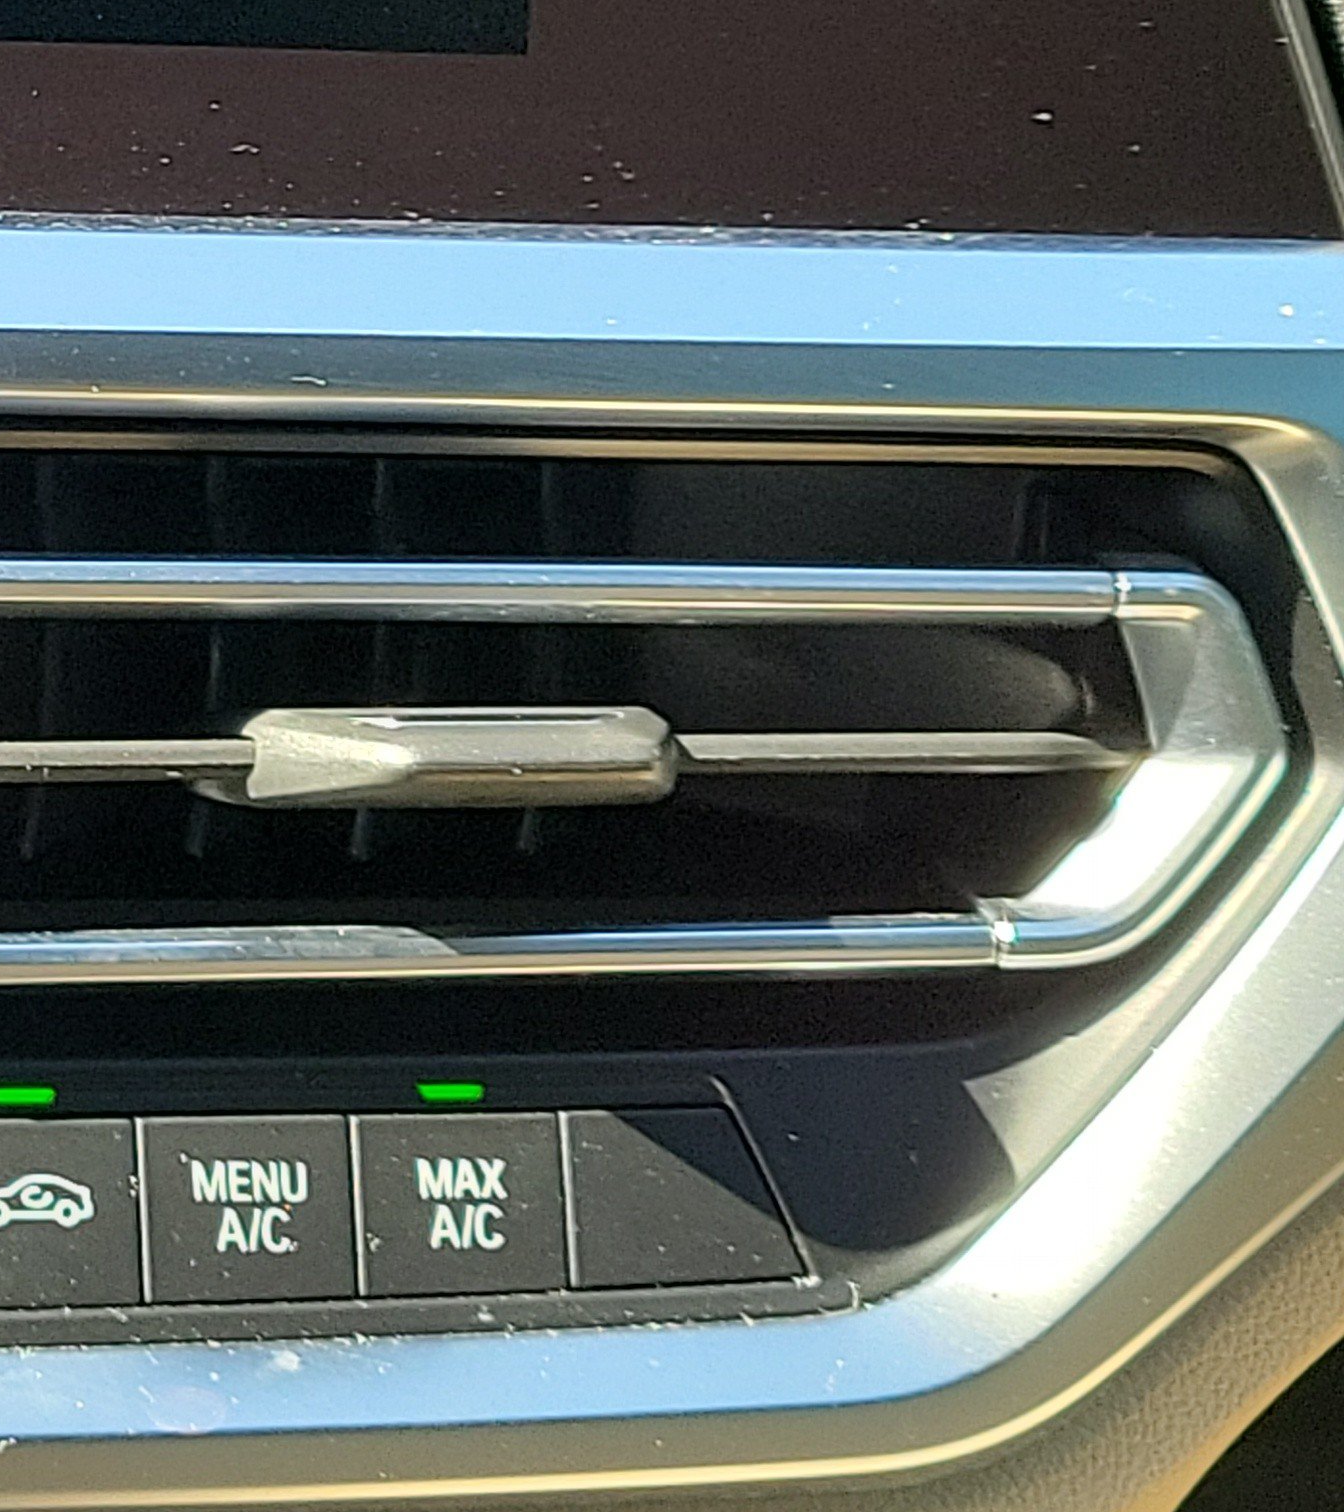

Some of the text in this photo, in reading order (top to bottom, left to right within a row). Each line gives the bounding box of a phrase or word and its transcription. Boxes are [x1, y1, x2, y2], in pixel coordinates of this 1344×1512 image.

[191, 1160, 308, 1202] MENU
[416, 1158, 507, 1200] MAX
[216, 1208, 293, 1254] A/C
[430, 1205, 505, 1250] A/C
